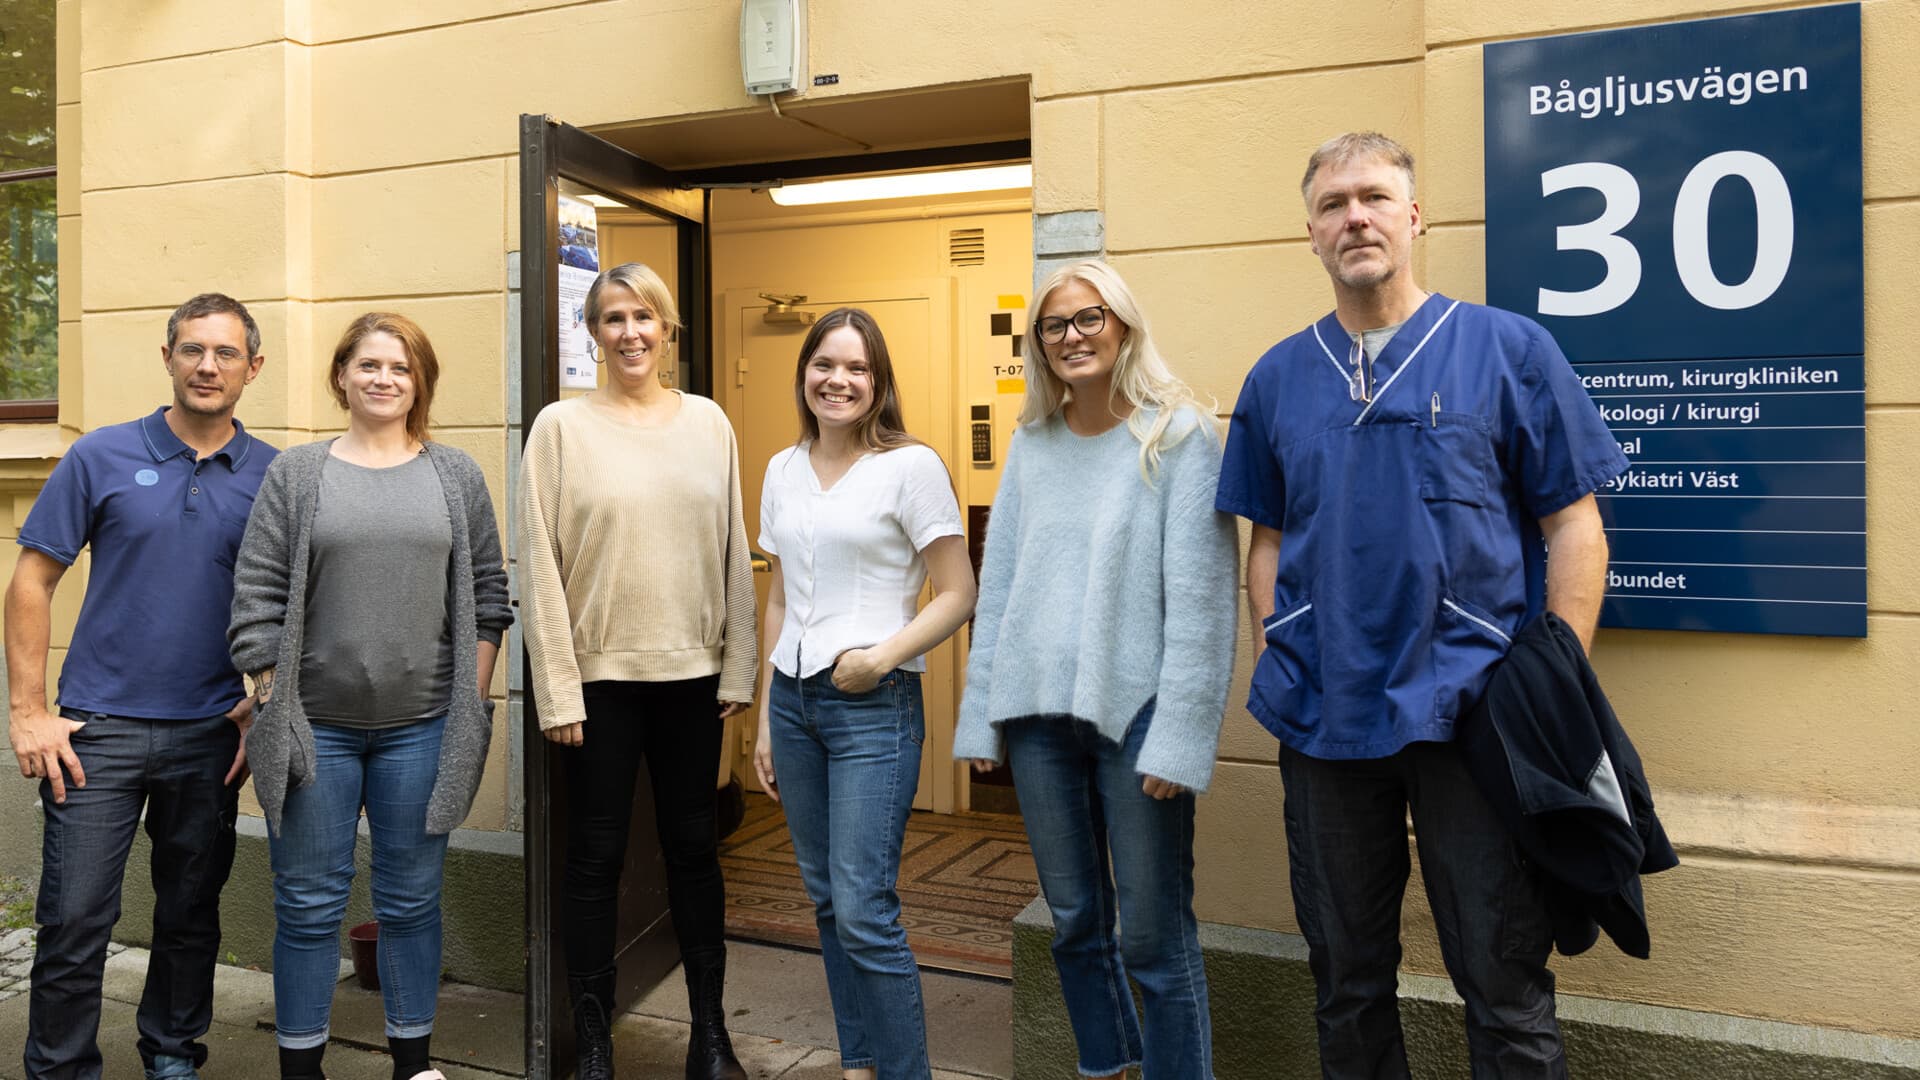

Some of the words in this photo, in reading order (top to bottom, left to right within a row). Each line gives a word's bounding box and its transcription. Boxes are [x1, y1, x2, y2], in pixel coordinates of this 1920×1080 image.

[1529, 66, 1808, 119] Bågljusvägen
[1537, 150, 1795, 317] 30
[1683, 367, 1839, 390] kirurgkliniken
[1672, 403, 1681, 421] /
[1687, 402, 1760, 424] kirurgi
[1595, 471, 1683, 492] sykiatri
[1690, 472, 1739, 488] Väst
[1606, 570, 1687, 590] bundet
